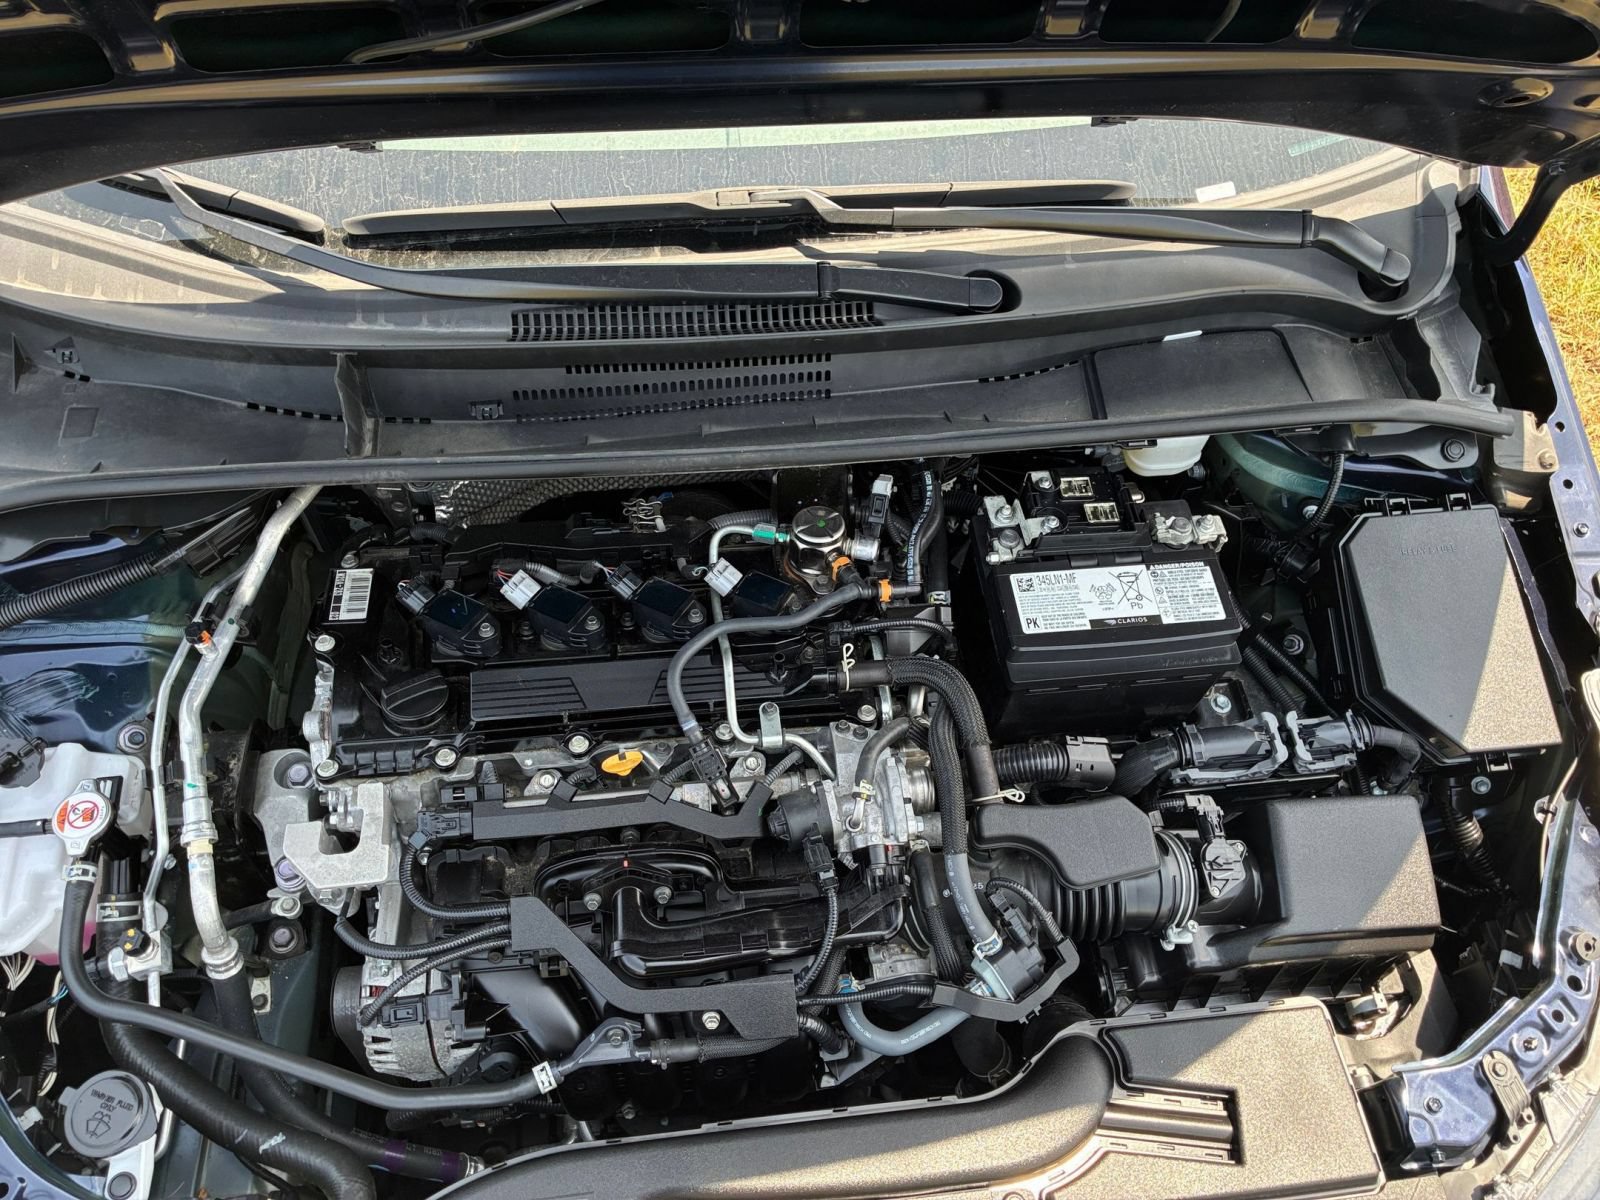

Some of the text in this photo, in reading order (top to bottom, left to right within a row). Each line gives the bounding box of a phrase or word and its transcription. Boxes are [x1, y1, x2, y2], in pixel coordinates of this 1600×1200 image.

[1036, 572, 1077, 586] 345LN1-MF
[1130, 601, 1144, 610] Pb
[1025, 617, 1040, 629] PK
[1117, 617, 1148, 625] CLARIOS
